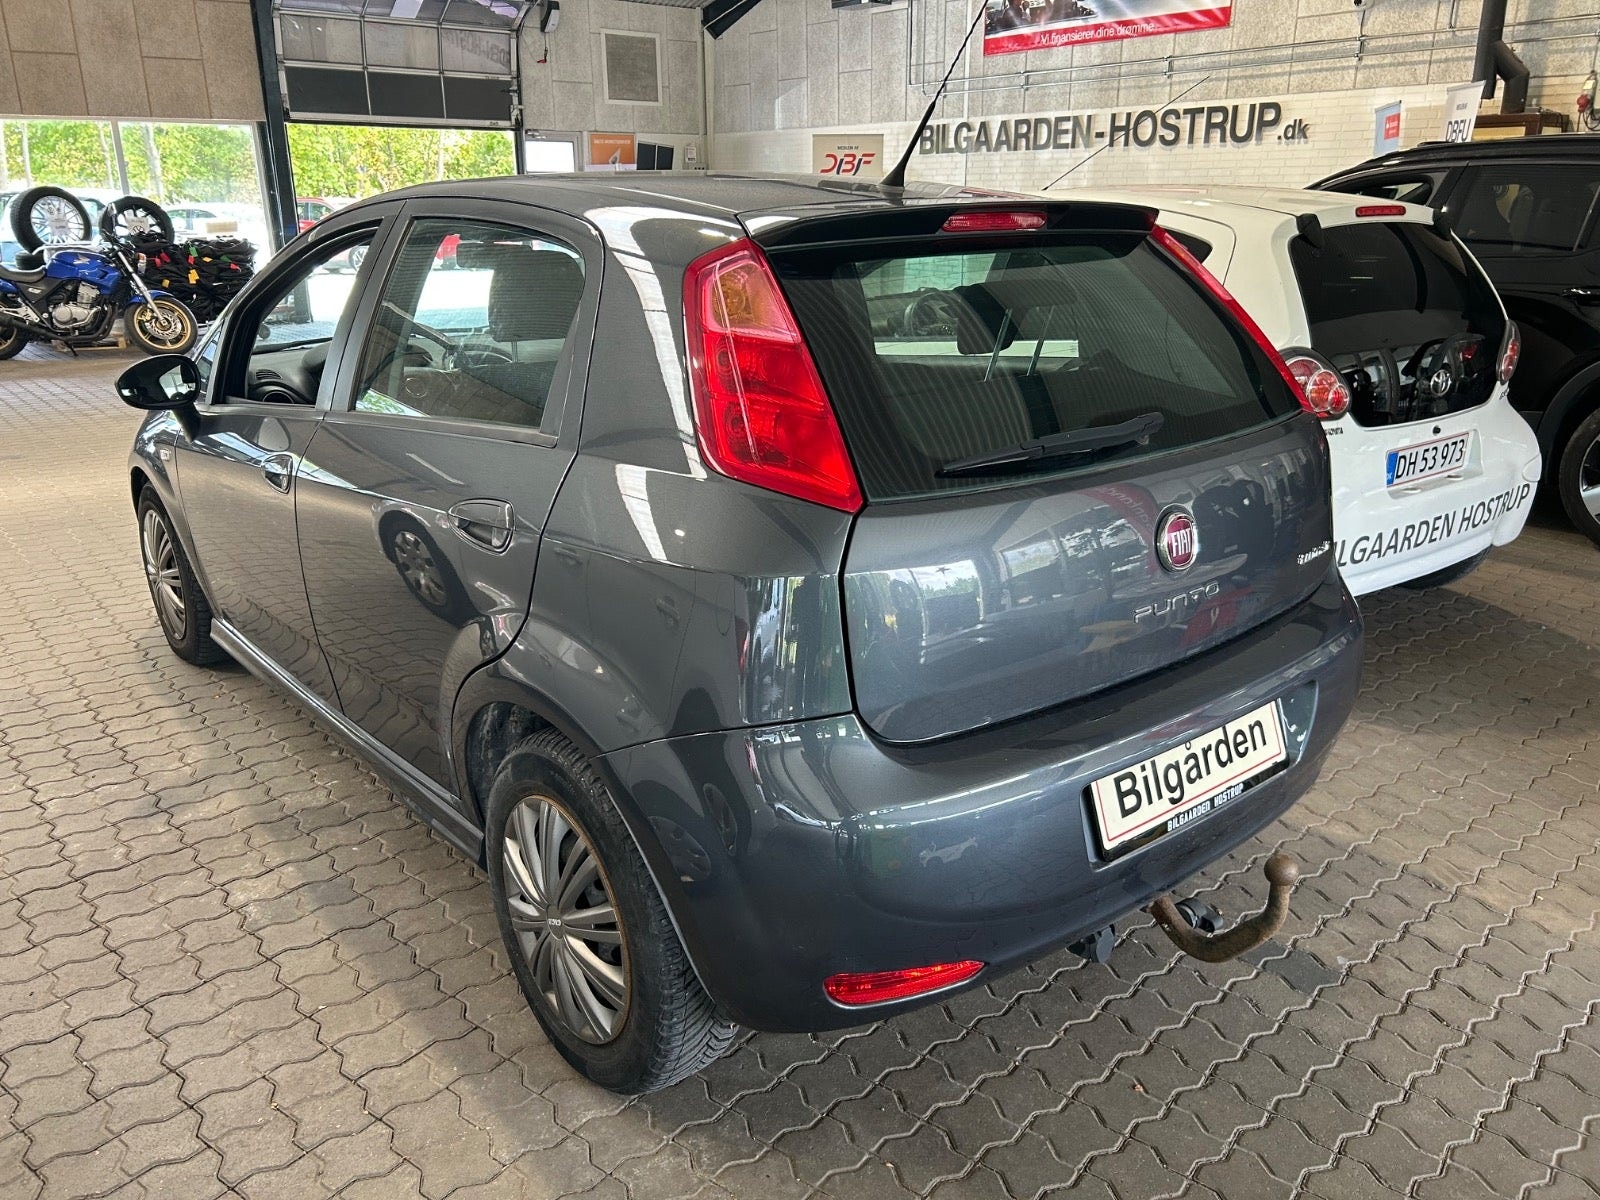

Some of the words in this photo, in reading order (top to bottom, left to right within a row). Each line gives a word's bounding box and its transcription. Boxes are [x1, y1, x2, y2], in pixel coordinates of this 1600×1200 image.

[1095, 26, 1115, 39] dine
[1395, 451, 1418, 479] DH
[1419, 446, 1438, 473] 53
[1441, 439, 1465, 468] 973
[1171, 527, 1191, 557] FIAT
[1333, 511, 1456, 567] LGAARDEN
[1457, 483, 1530, 534] HOSTRUP
[1113, 719, 1267, 818] Bilgården
[1167, 801, 1211, 832] BILGAARDEN
[1214, 783, 1244, 807] HOSTRUP
